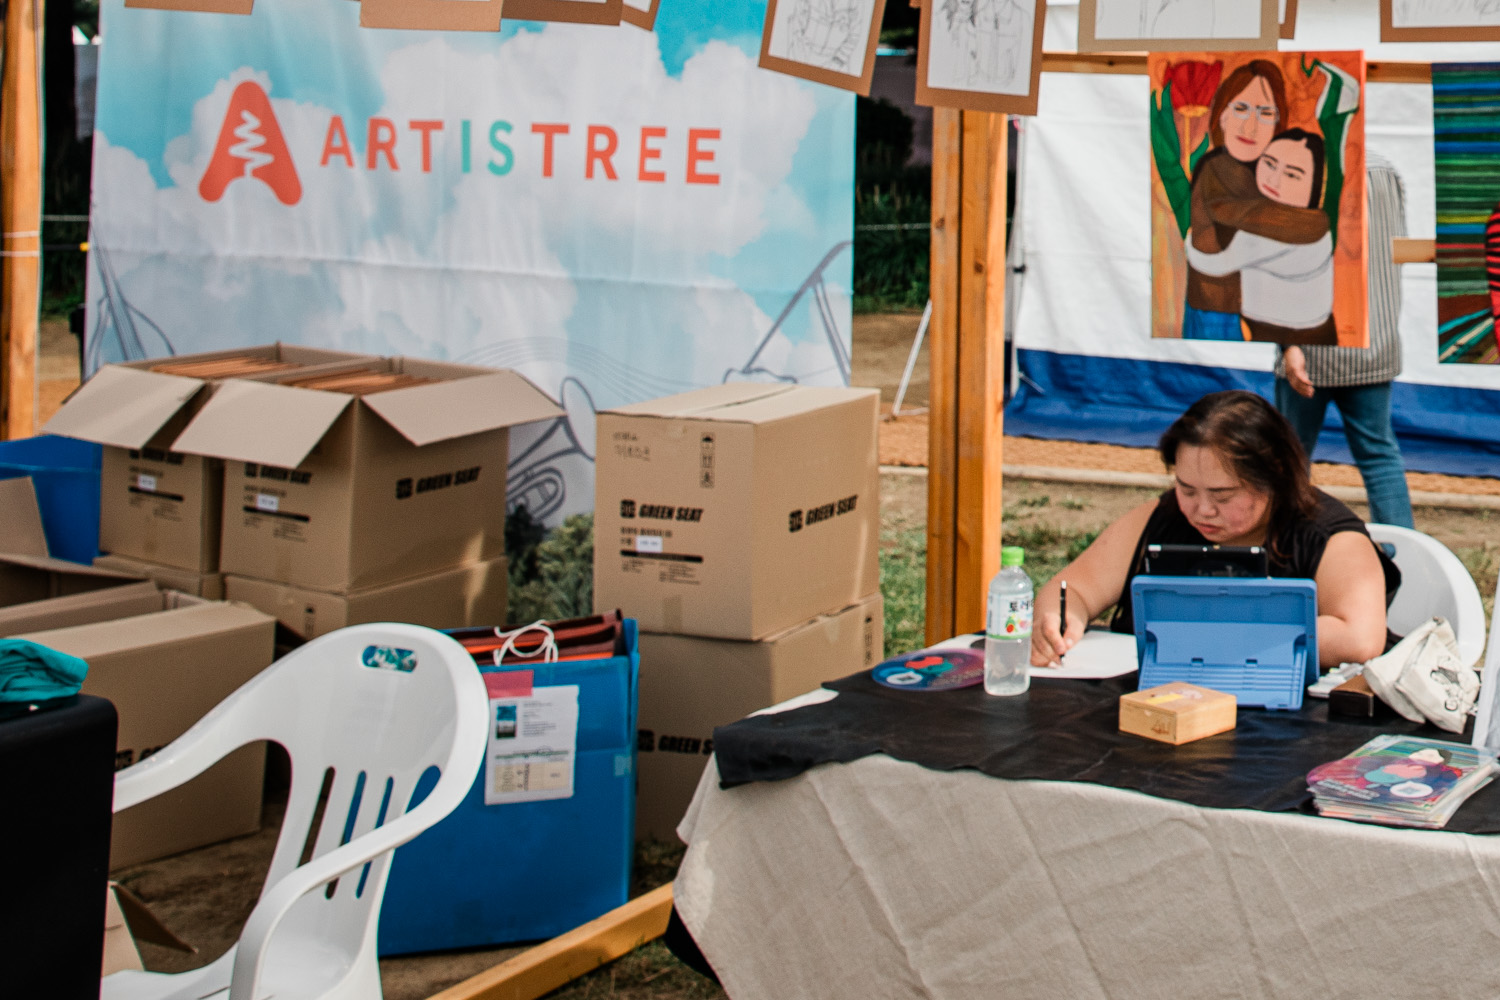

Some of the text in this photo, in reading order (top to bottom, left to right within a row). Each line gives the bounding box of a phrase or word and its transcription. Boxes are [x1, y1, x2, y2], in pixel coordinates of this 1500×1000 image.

[320, 115, 722, 185] ARTISTREE
[639, 504, 703, 522] GREEN SEAT
